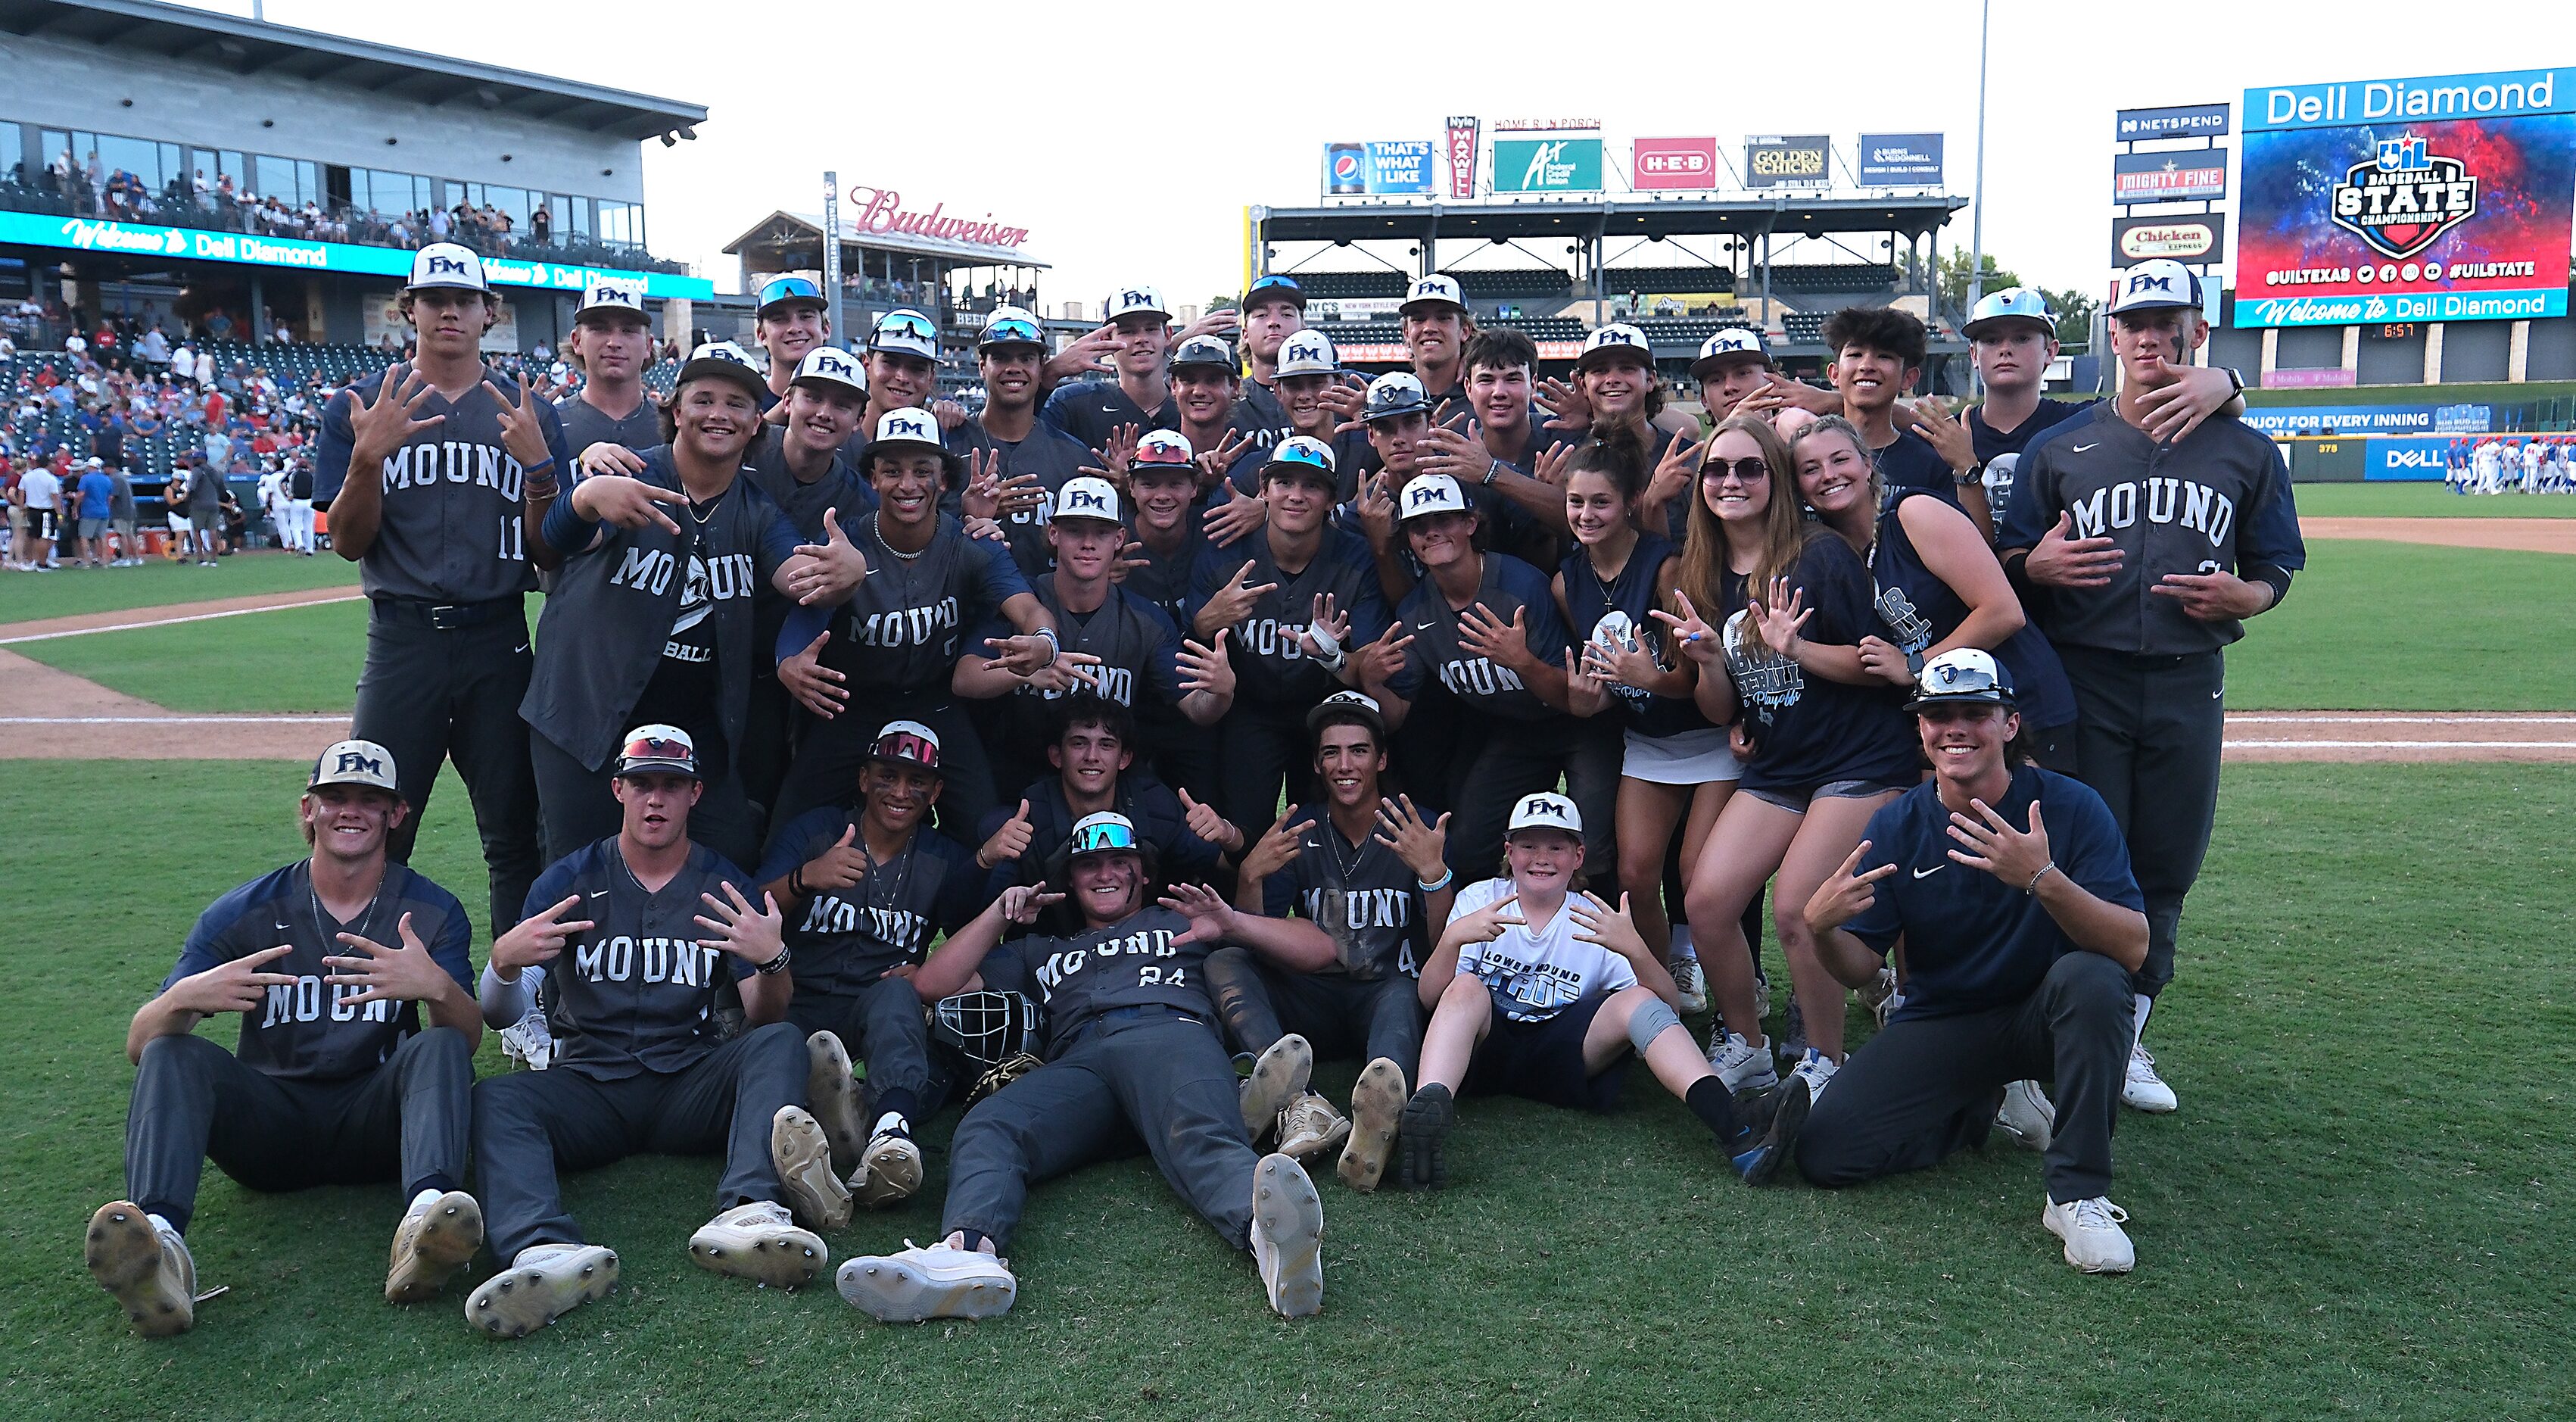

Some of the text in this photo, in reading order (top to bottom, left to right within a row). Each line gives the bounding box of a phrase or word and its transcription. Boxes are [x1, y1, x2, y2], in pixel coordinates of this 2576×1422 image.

[2267, 71, 2554, 124] Dell Diamond
[1449, 117, 1474, 129] Nyle
[1495, 117, 1602, 129] HOME RUN PORCH
[2140, 114, 2223, 131] NETSPEND
[1374, 142, 1429, 156] THAT'S
[1755, 150, 1823, 164] GOLDEN
[1374, 156, 1422, 170] WHAT
[1453, 130, 1471, 198] MAXWELL
[1522, 140, 1568, 191] A+
[1761, 161, 1816, 175] CHICK
[1376, 170, 1421, 184] I LIKE
[2122, 169, 2219, 191] MIGHTY FINE
[2368, 170, 2441, 187] BASEBALL
[2337, 182, 2472, 216] STATE
[851, 186, 1029, 248] Budweiser
[2360, 211, 2445, 226] CHAMPIONSHIPS
[61, 217, 164, 249] Welcome
[196, 234, 235, 257] Dell
[240, 238, 328, 267] Diamond
[2135, 229, 2202, 243] Chicken
[425, 256, 469, 276] FM
[2266, 260, 2535, 287] @UILTEXAS #UILSTATE
[554, 267, 583, 288] Dell
[2126, 273, 2174, 298] FM
[593, 288, 631, 304] FM
[1122, 290, 1155, 310] FM
[1416, 281, 1449, 301] FM
[2255, 293, 2546, 326] Welcome to Dell Diamond
[1597, 332, 1634, 348] FM
[2384, 323, 2415, 338] 6:57
[1287, 344, 1322, 363] FM
[1712, 338, 1746, 356] FM
[816, 356, 855, 382] FM
[887, 419, 927, 438] FM
[2288, 416, 2319, 429] FOR
[2322, 415, 2372, 428] EVERY
[2374, 413, 2429, 427] INNING
[2386, 448, 2444, 469] DELL
[383, 441, 524, 504] MOUND
[1067, 491, 1108, 512] FM
[1411, 487, 1451, 510] FM
[2073, 478, 2233, 548] MOUND
[499, 516, 524, 562] 11
[662, 641, 712, 663] BALL
[1752, 688, 1802, 710] Playoffs
[332, 752, 385, 779] FM
[1523, 799, 1568, 822] FM
[1302, 887, 1412, 931] MOUND
[1397, 938, 1420, 979] 4
[1138, 965, 1185, 988] 24
[1534, 962, 1581, 984] MOUND
[261, 975, 403, 1030] MOUN
